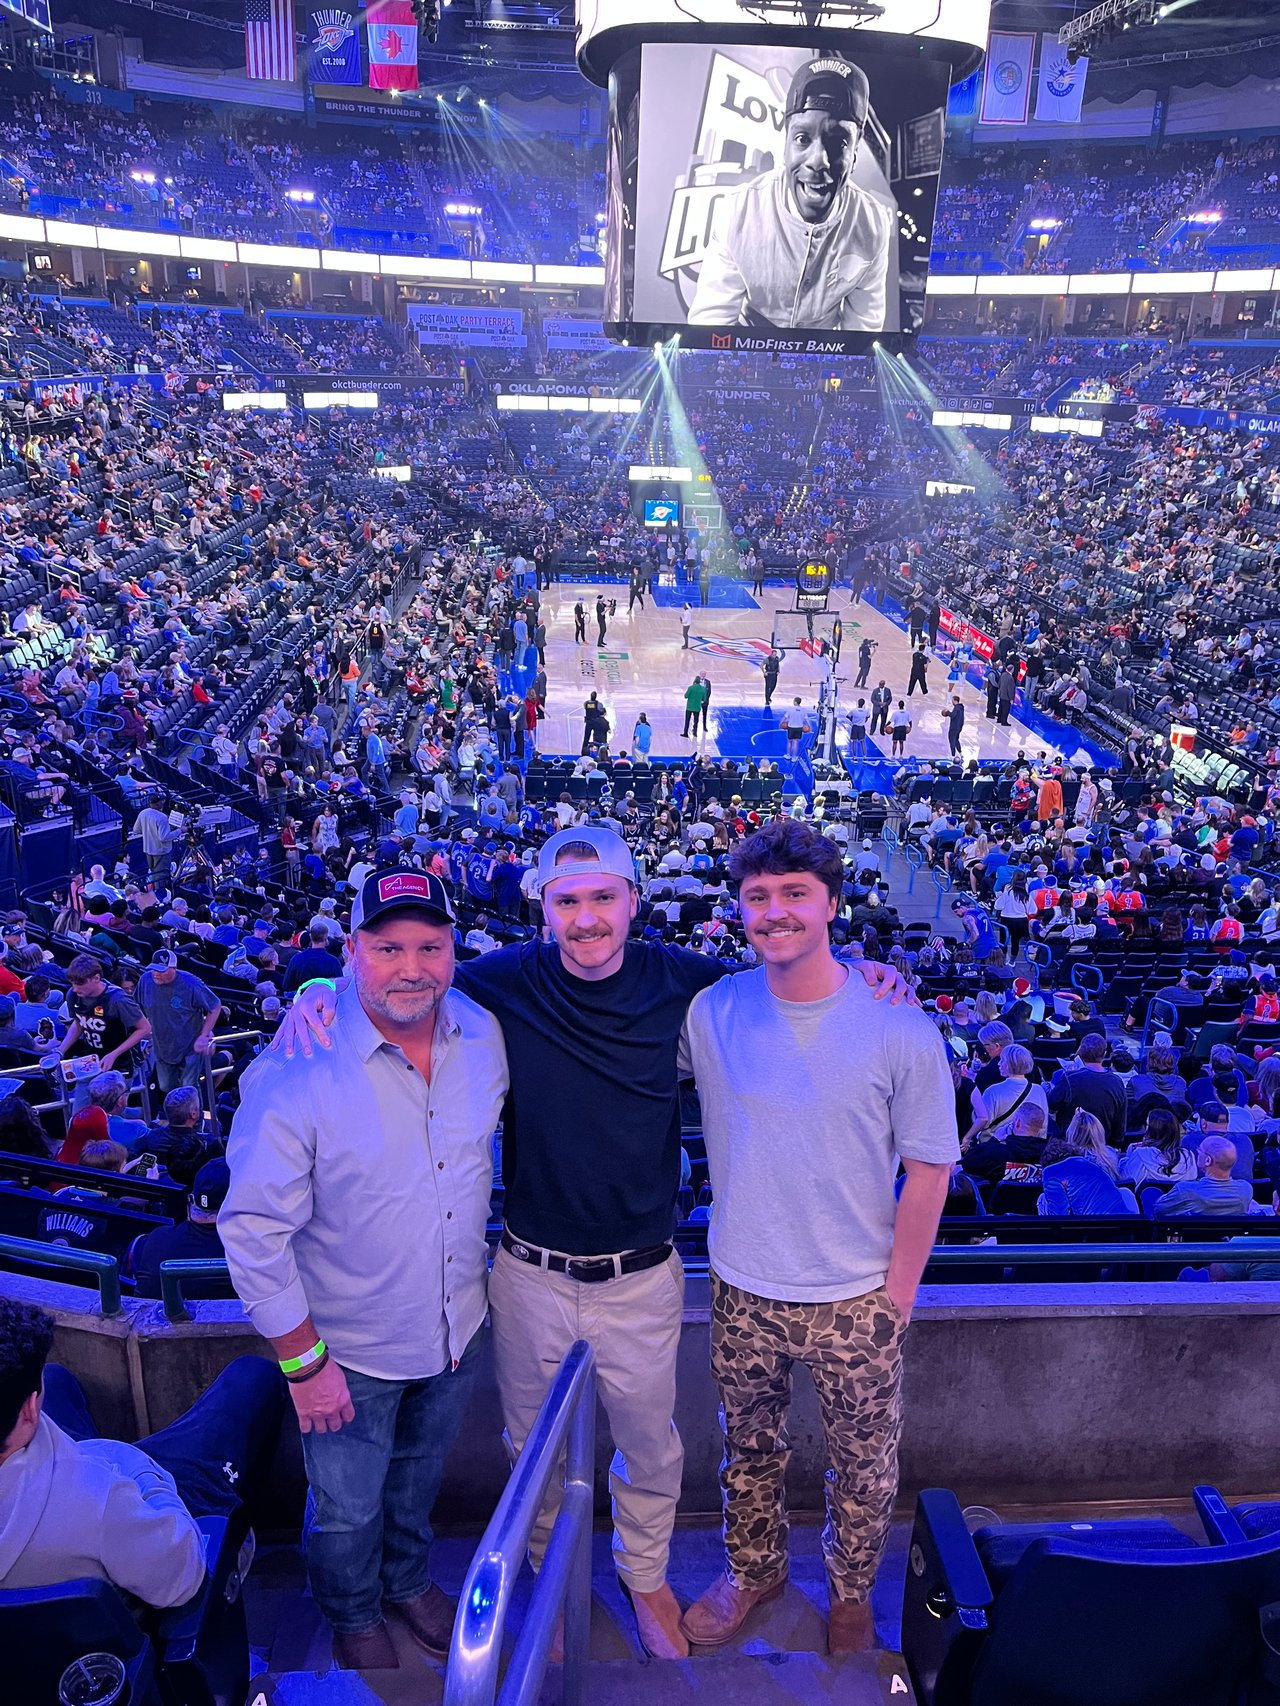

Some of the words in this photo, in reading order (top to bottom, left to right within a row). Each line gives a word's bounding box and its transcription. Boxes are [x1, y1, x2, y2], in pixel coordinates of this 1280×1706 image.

[311, 9, 352, 29] THUNDER
[321, 31, 340, 44] OKC
[809, 59, 852, 79] THUNDER
[86, 89, 102, 104] 313
[325, 102, 355, 112] BRING
[357, 104, 376, 114] THE
[377, 106, 421, 118] THUNDER
[420, 314, 436, 323] POST
[445, 315, 458, 324] OAK
[460, 316, 483, 325] PARTY
[484, 317, 515, 327] TERRACE
[331, 379, 402, 390] okcthunder.com
[706, 390, 771, 400] THUNDER
[1023, 403, 1035, 412] 112
[1058, 404, 1071, 415] 113
[473, 867, 481, 880] 2
[46, 1213, 94, 1238] WILLIAMS
[890, 1674, 909, 1694] A
[251, 1692, 268, 1706] A
